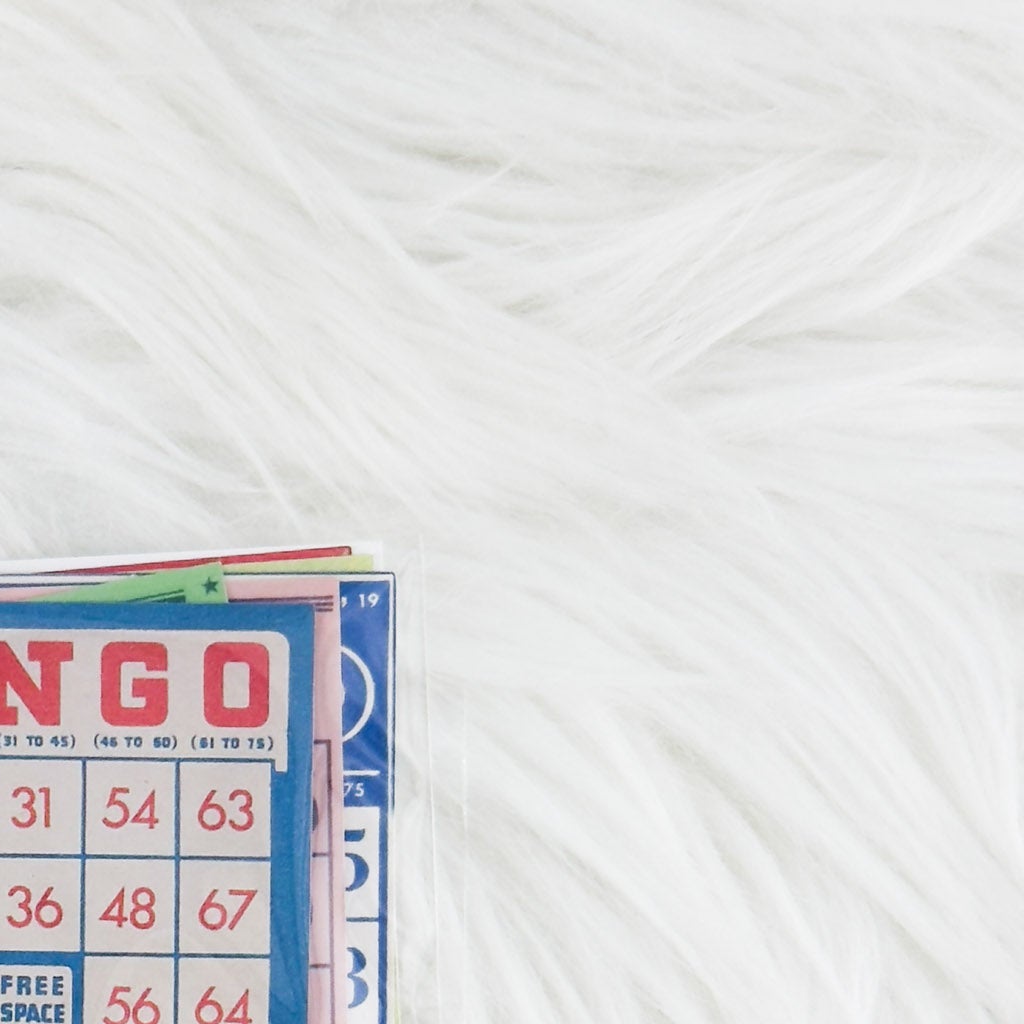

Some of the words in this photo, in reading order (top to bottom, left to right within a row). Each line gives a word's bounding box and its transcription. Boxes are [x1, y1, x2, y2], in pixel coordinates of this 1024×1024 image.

[358, 592, 379, 608] 19
[25, 735, 44, 748] TO
[50, 734, 76, 749] 45)
[124, 736, 143, 748] TO
[221, 737, 240, 750] TO
[247, 736, 274, 751] 75)
[11, 786, 51, 829] 31
[102, 787, 159, 830] 54
[197, 789, 254, 832] 63
[6, 885, 64, 929] 36
[99, 887, 156, 931] 48
[197, 890, 258, 932] 67
[0, 974, 64, 996] FREE
[0, 1002, 66, 1024] SPACE
